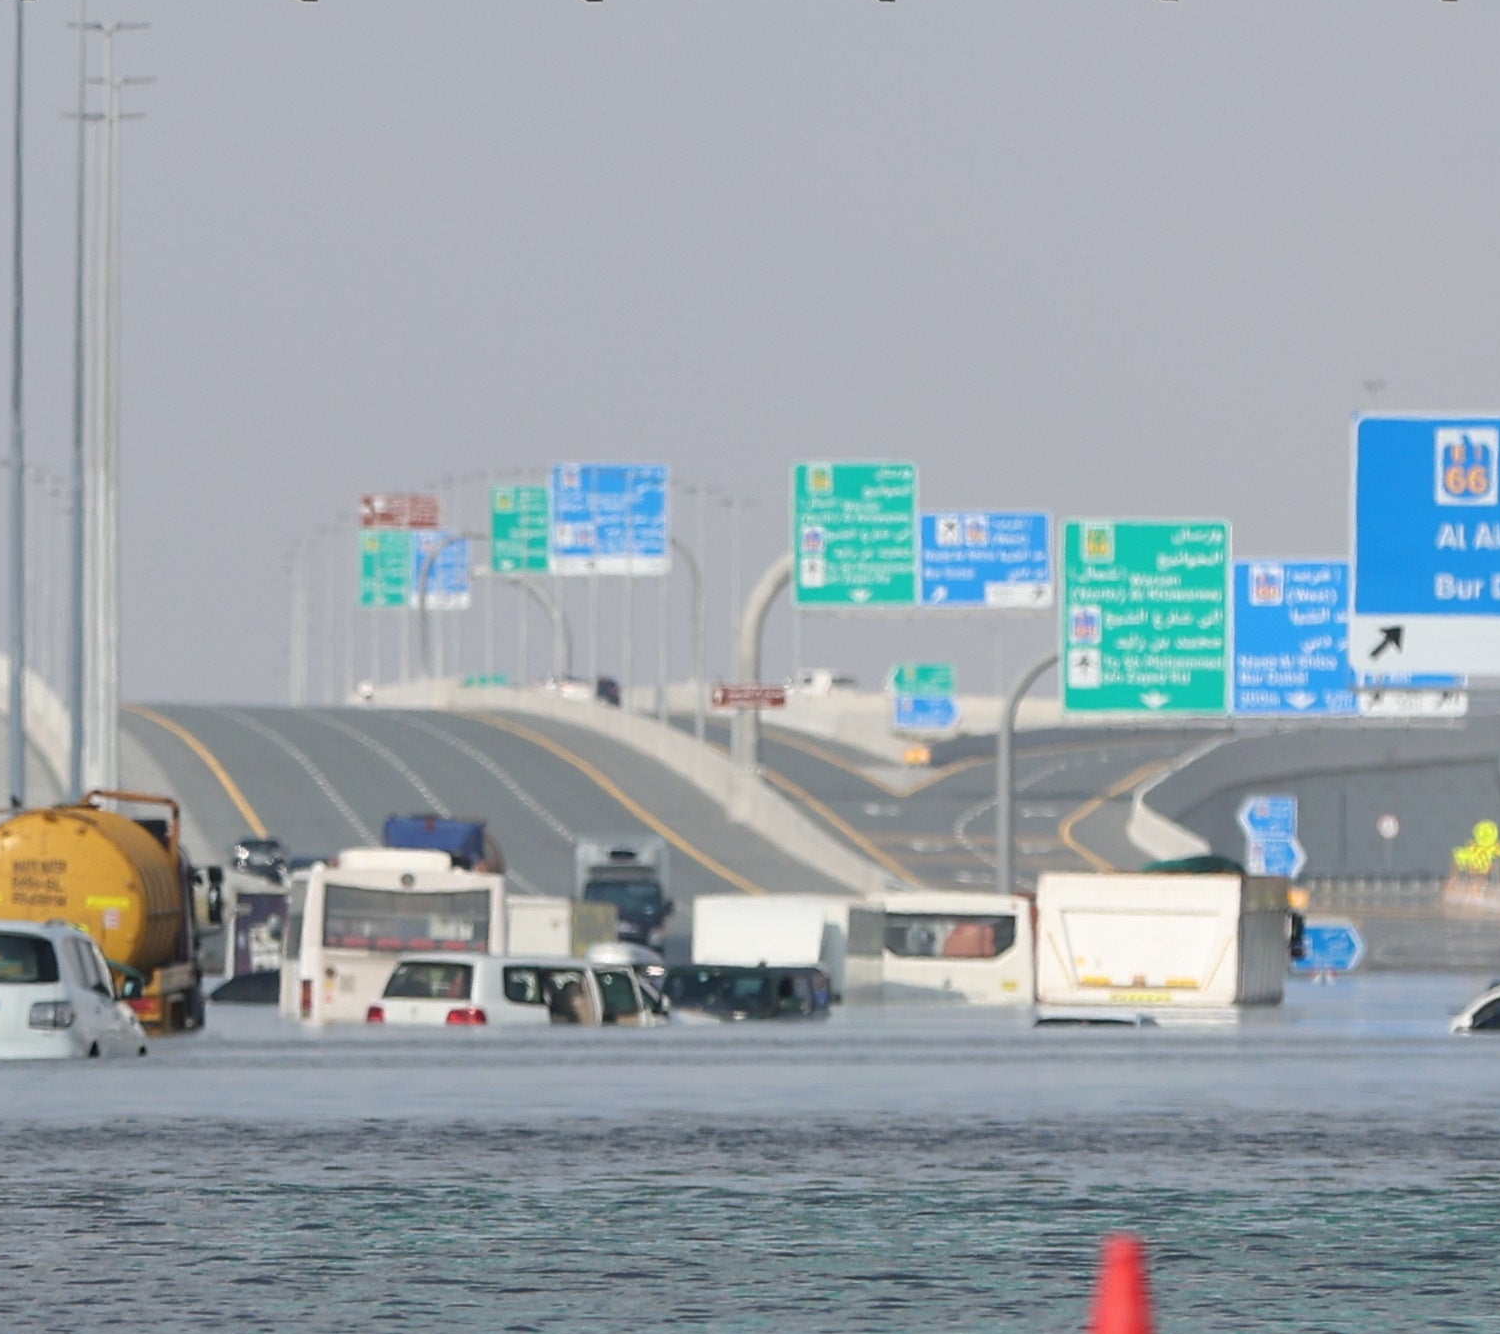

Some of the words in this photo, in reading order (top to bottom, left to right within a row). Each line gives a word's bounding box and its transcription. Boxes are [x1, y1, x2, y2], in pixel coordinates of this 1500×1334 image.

[1446, 467, 1487, 493] 66
[1438, 524, 1465, 548] Al
[1435, 574, 1483, 599] Bur
